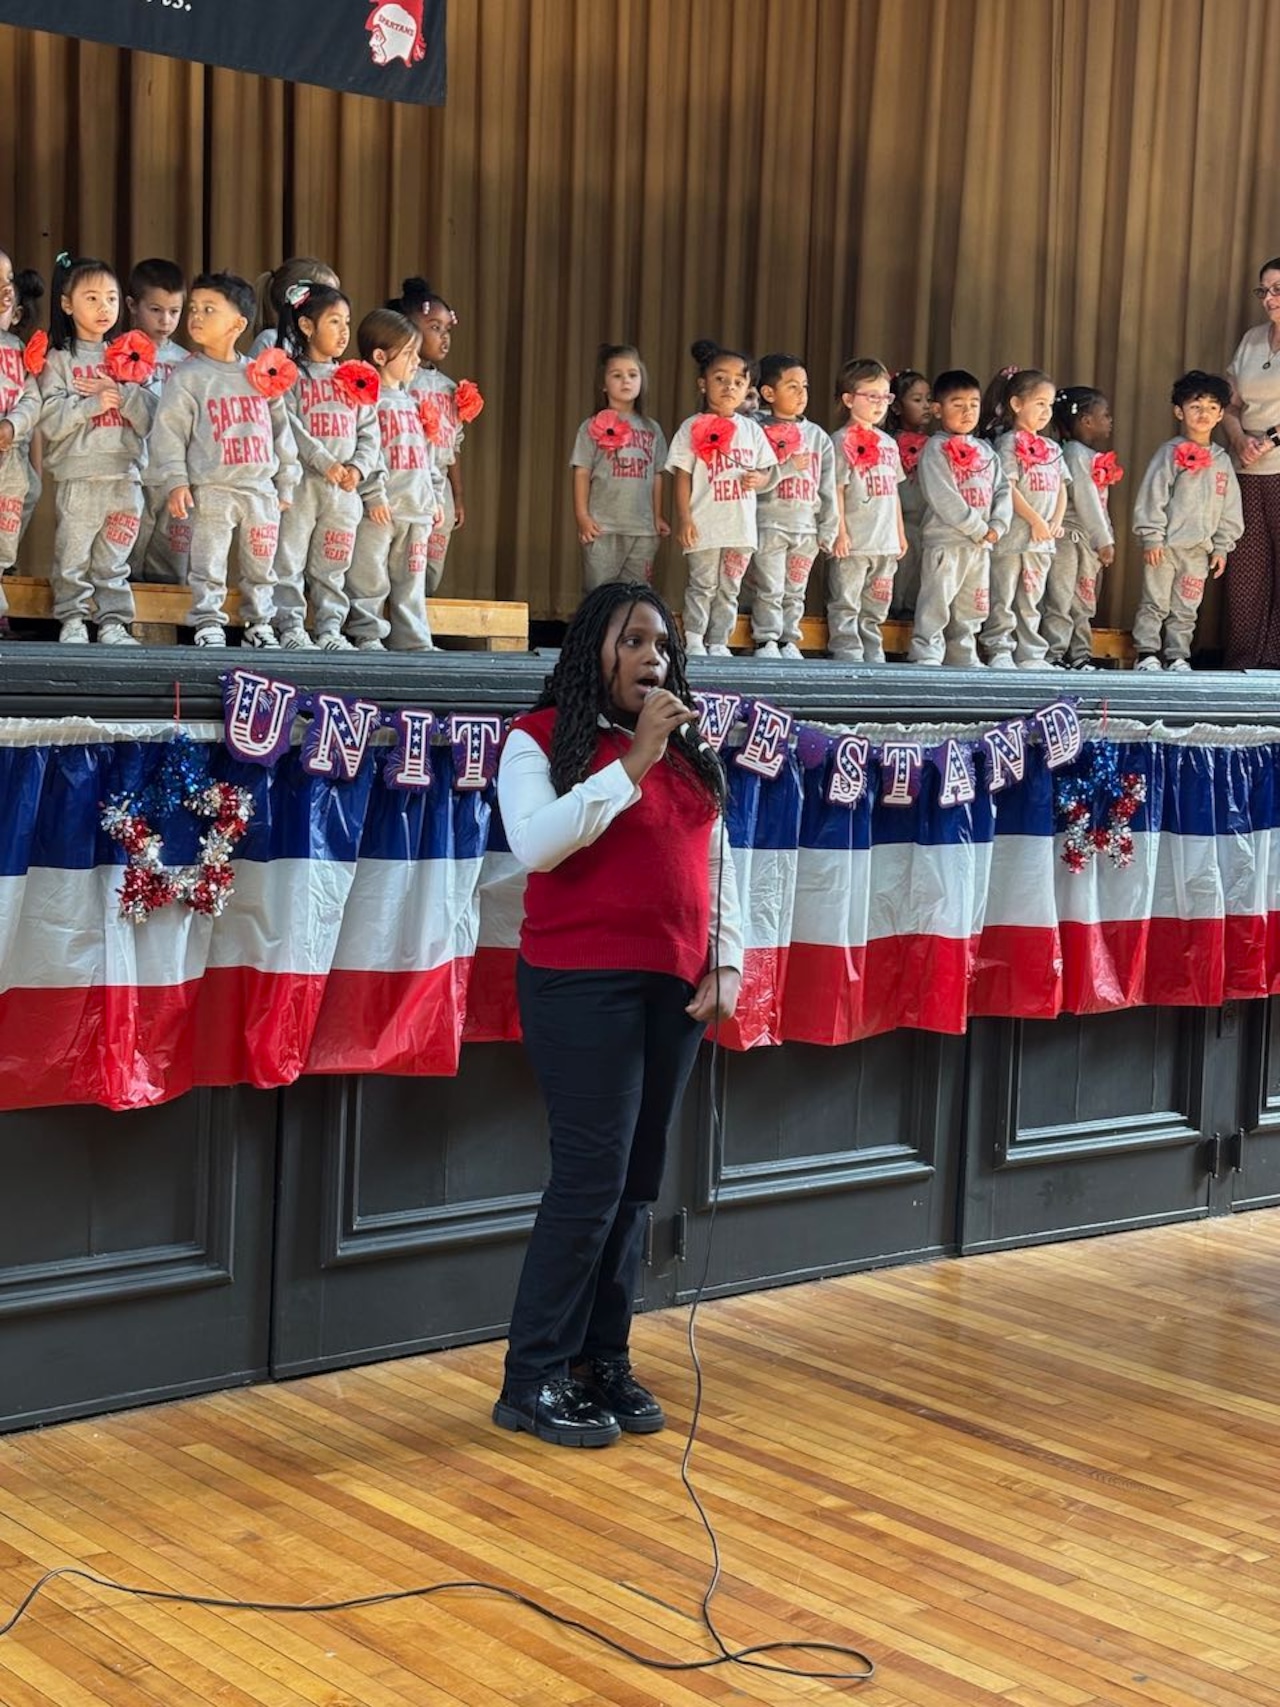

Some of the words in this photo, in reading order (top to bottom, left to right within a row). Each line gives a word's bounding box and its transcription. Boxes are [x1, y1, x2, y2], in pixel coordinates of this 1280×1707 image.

[300, 378, 357, 416] SACRE
[377, 408, 423, 449] SACR
[221, 436, 271, 465] HEART
[612, 456, 648, 480] HEART
[714, 479, 753, 502] HEA
[777, 477, 817, 501] HEART
[229, 670, 501, 788] UNIT
[689, 690, 793, 778] WE
[829, 703, 1080, 805] STAND
